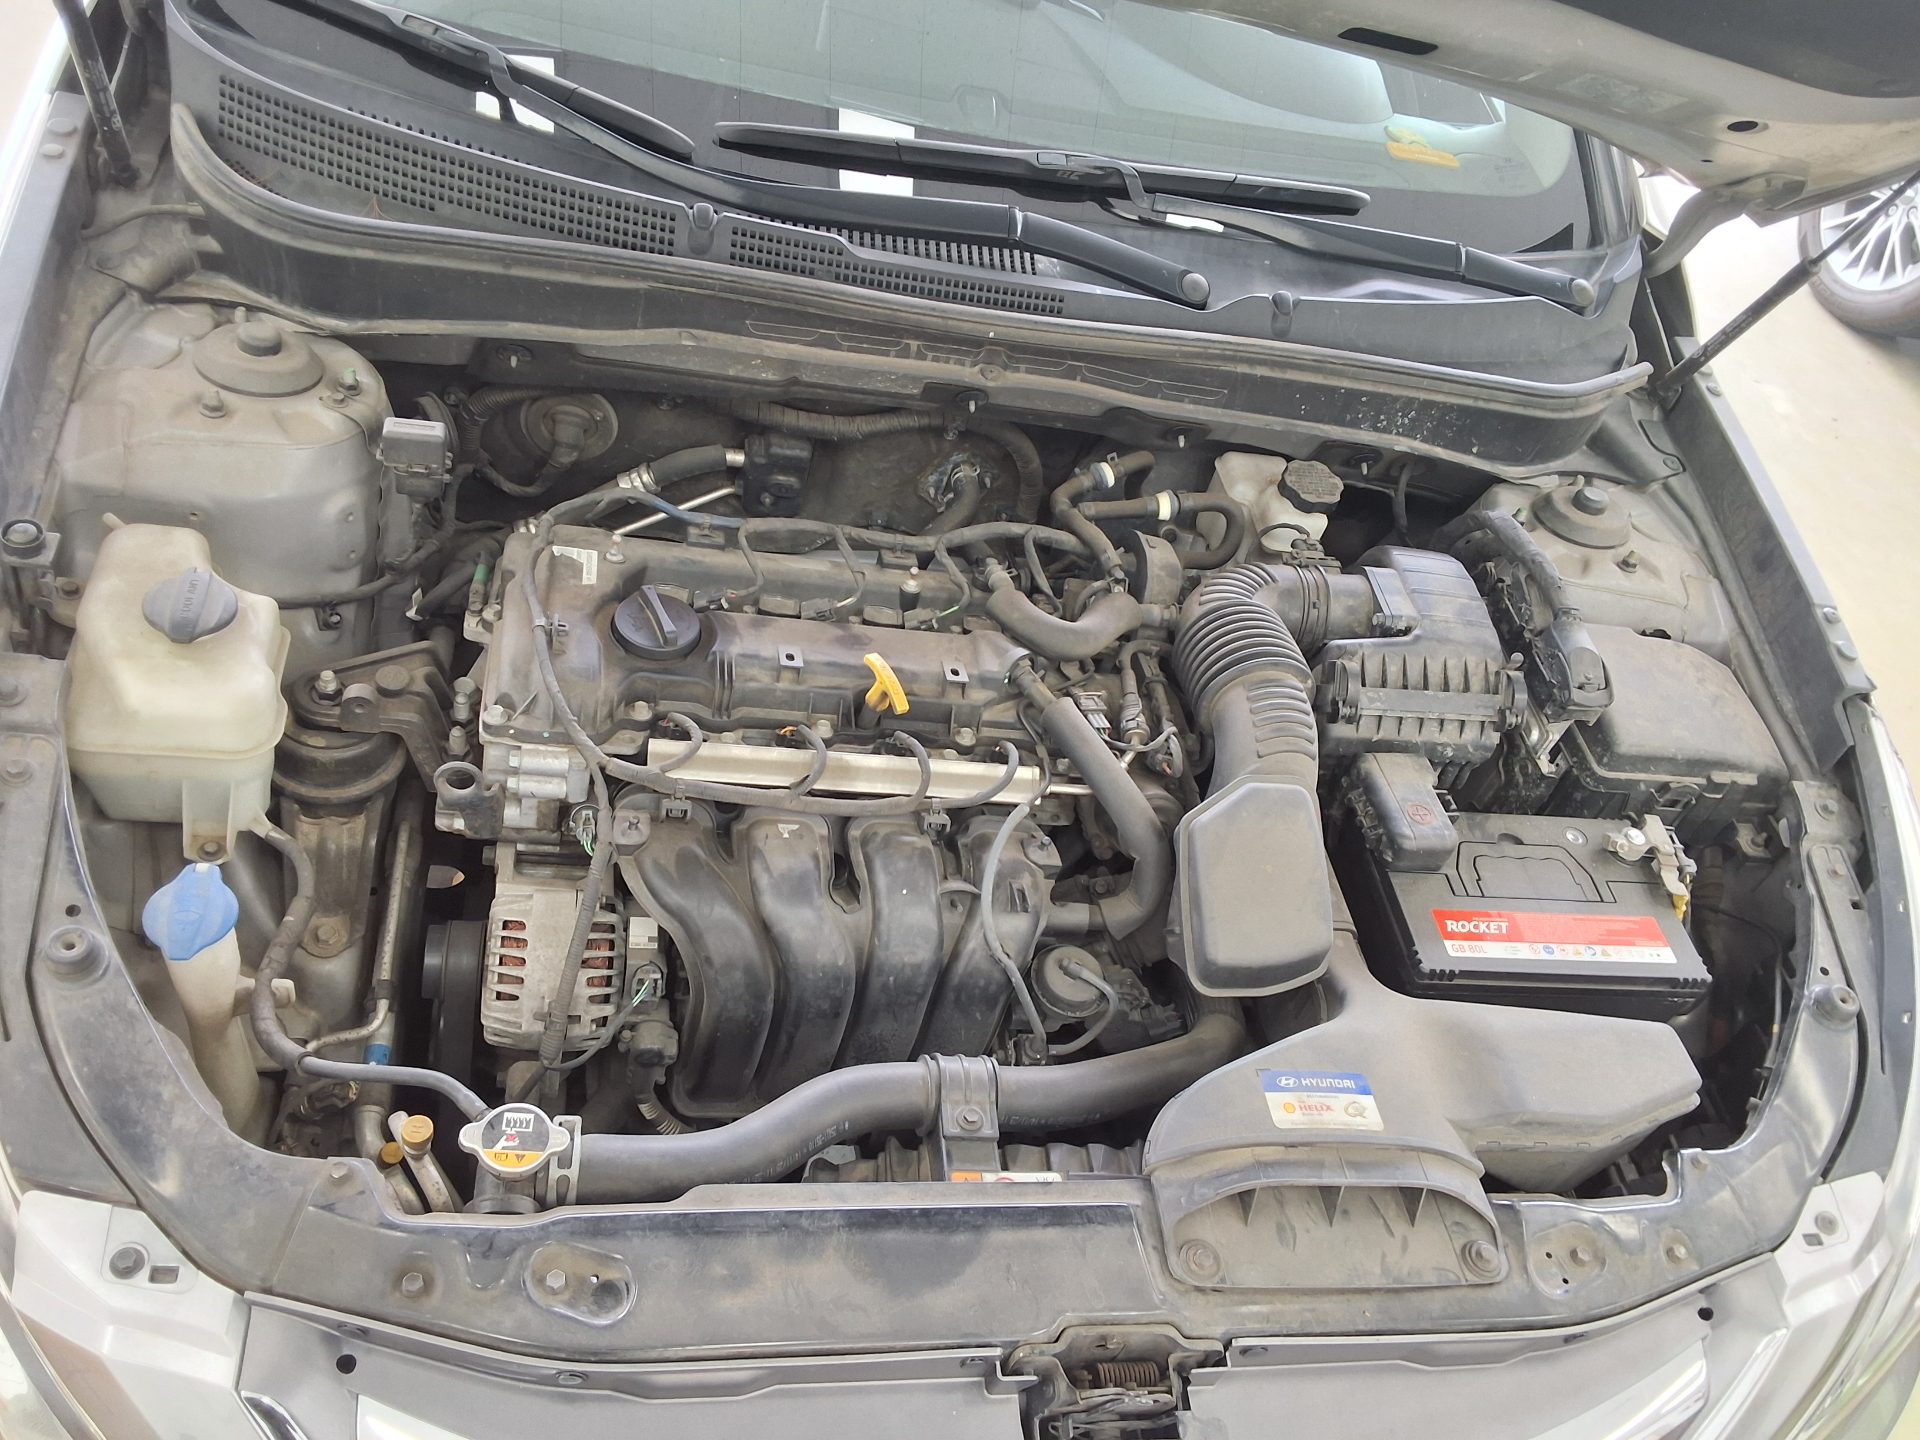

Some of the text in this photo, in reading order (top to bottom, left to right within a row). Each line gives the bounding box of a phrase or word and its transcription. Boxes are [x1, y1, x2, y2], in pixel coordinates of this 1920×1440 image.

[1445, 919, 1509, 934] ROCKET
[1451, 943, 1466, 953] GB
[1301, 1077, 1356, 1089] HYUNDAI
[1298, 1103, 1335, 1112] HELIX
